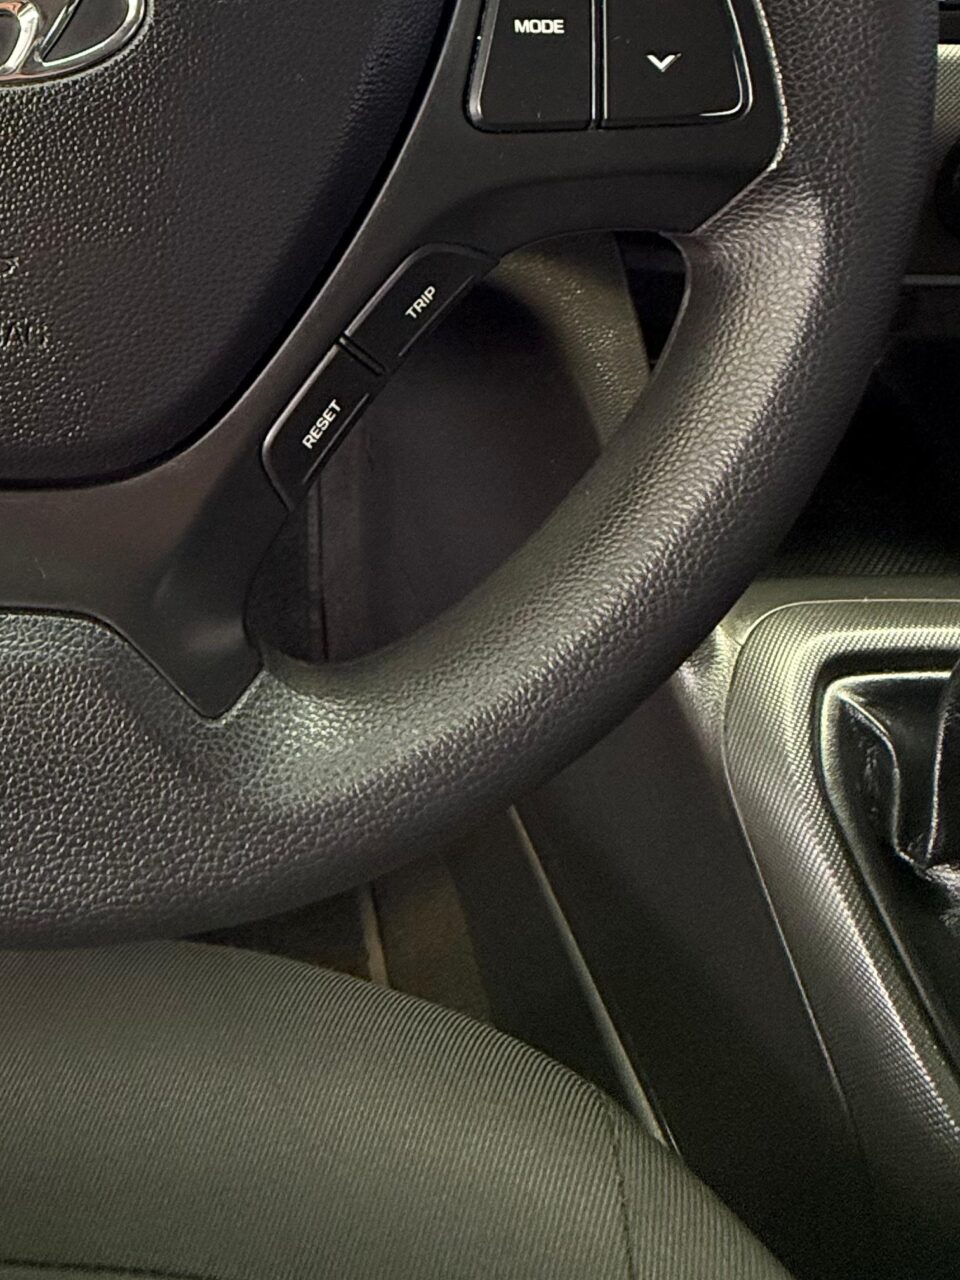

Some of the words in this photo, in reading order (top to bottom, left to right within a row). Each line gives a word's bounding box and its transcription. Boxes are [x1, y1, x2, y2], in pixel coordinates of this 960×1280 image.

[514, 19, 565, 34] MODE
[404, 285, 436, 319] TRIP
[302, 399, 341, 449] RESET
